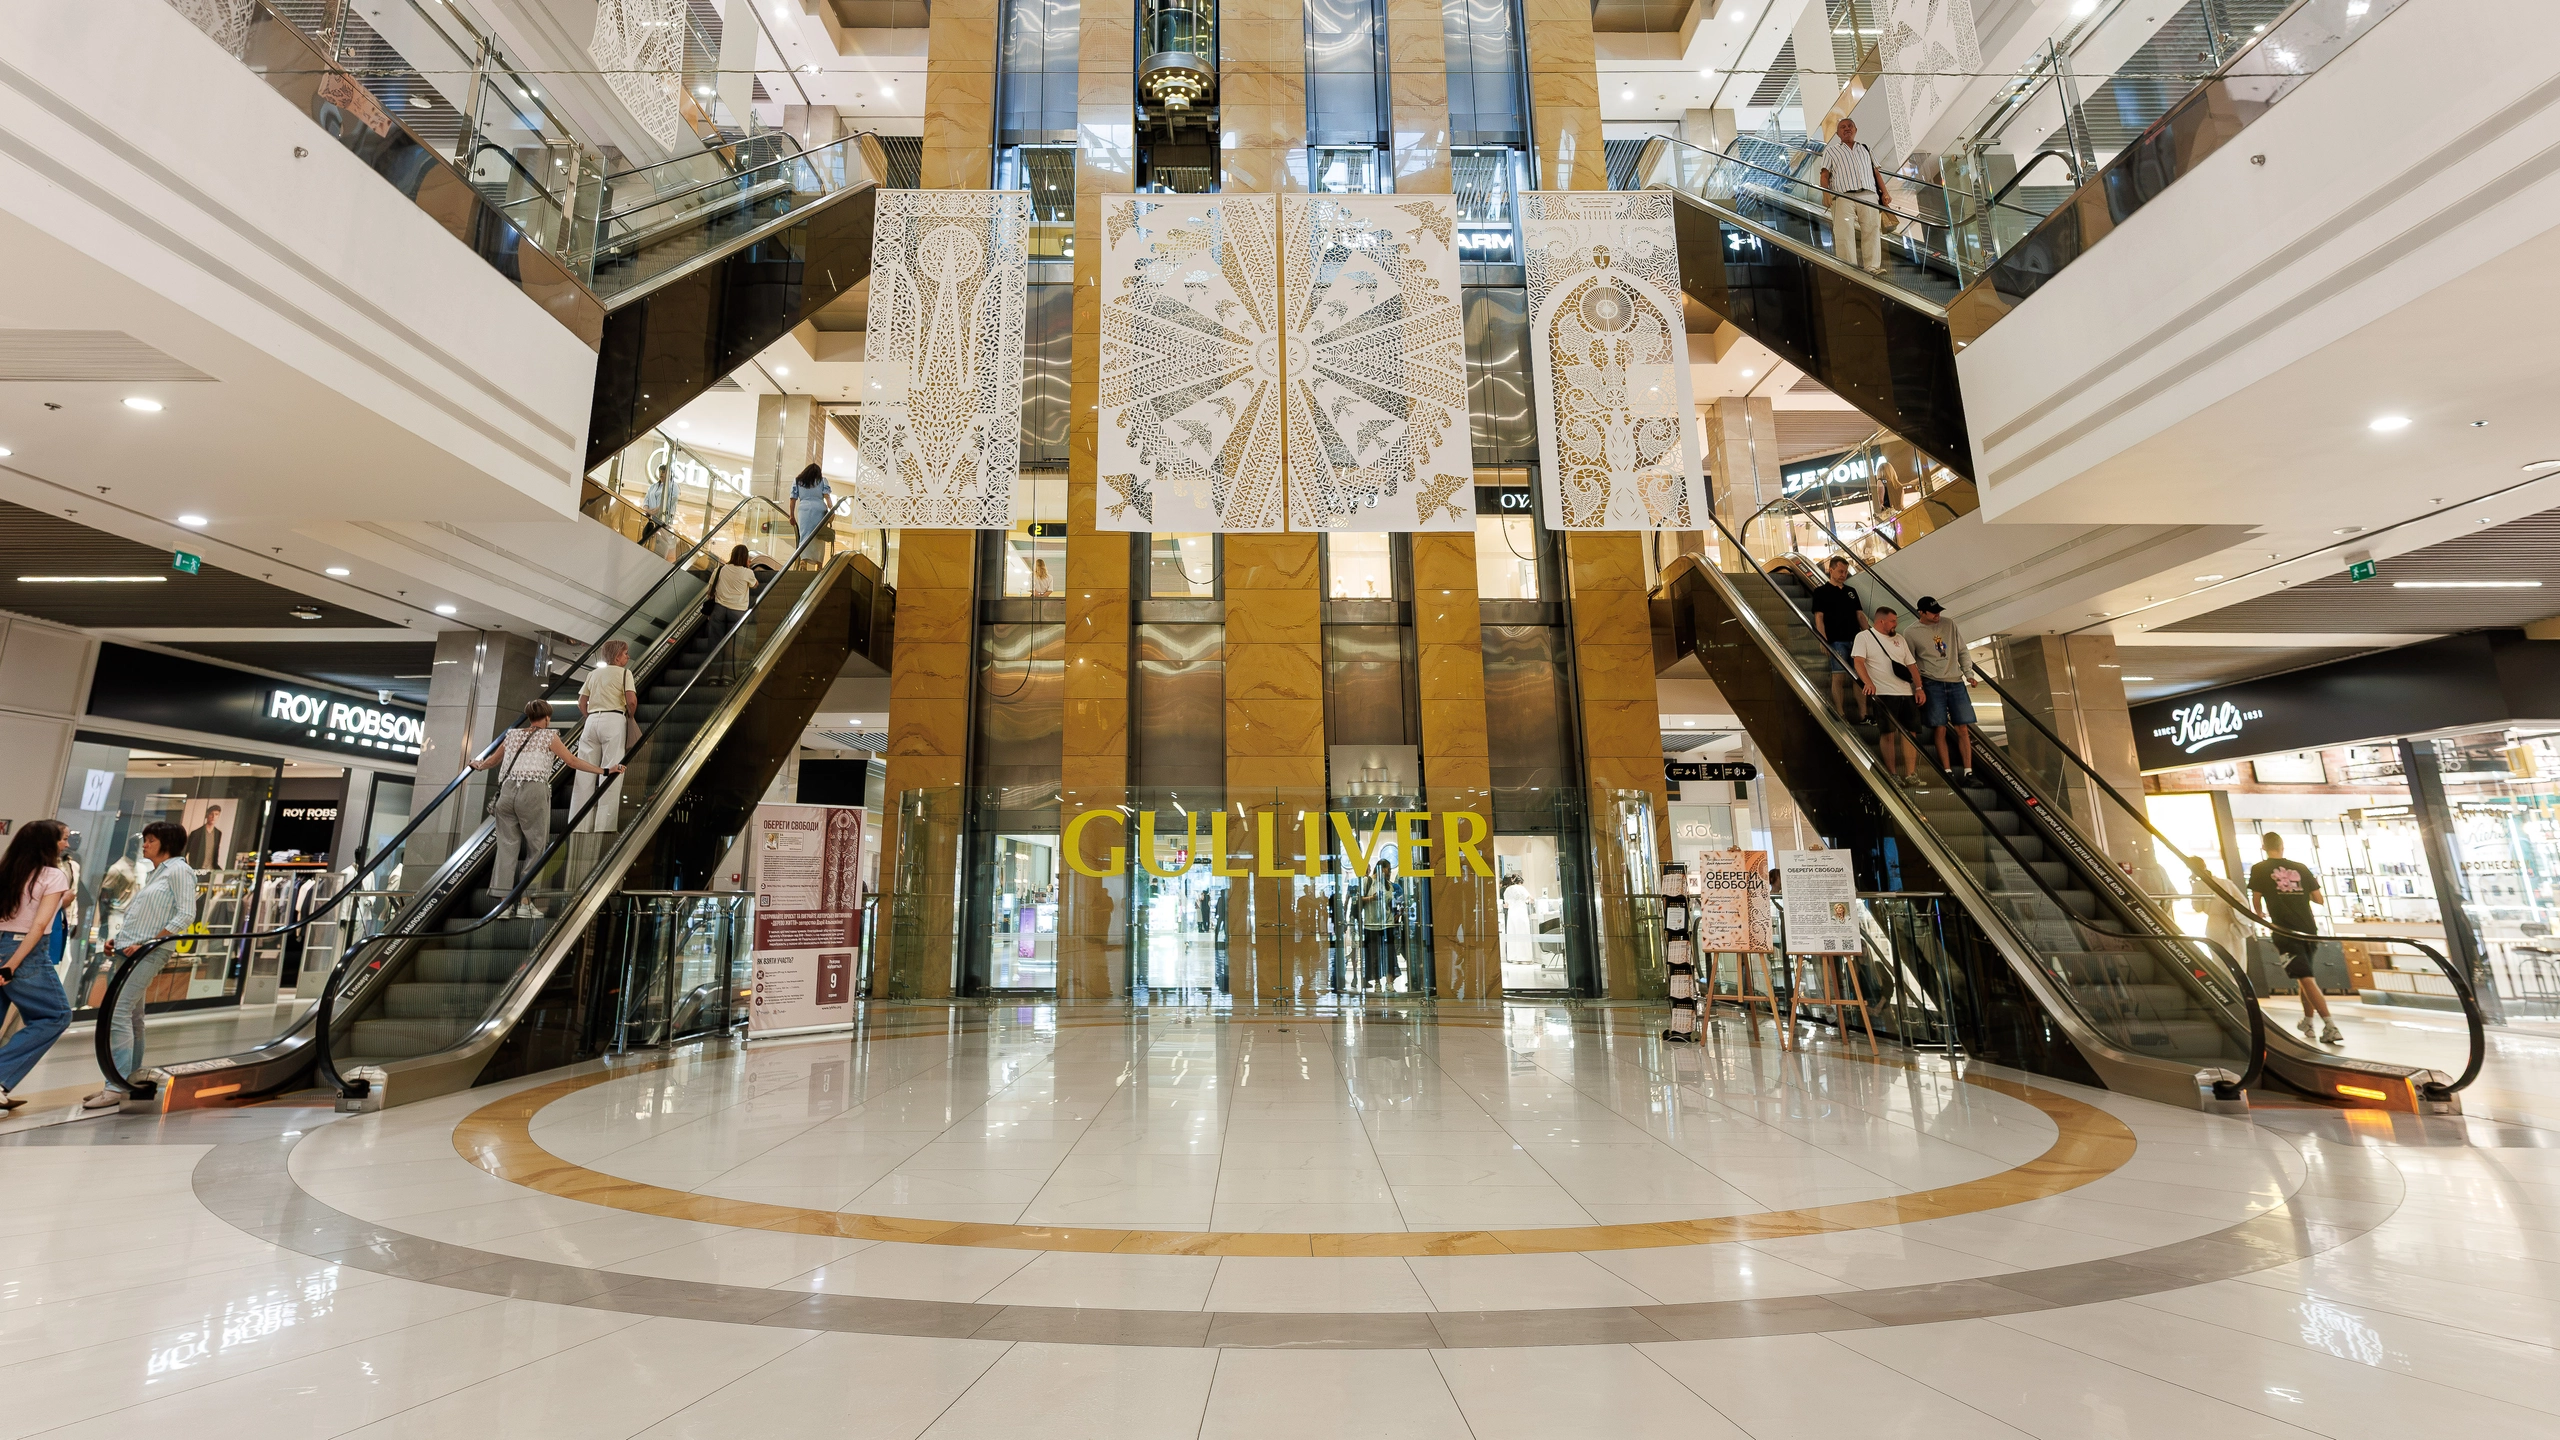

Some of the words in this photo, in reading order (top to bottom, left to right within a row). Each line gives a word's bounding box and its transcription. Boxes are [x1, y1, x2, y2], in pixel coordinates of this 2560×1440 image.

[1034, 525, 1042, 535] 2
[271, 689, 328, 725] ROY
[329, 702, 425, 744] ROBSON
[2171, 701, 2243, 747] Kiehl's
[282, 808, 306, 818] ROY
[763, 820, 790, 830] ОБЕРЕГИ
[791, 820, 819, 831] СВОБОДИ
[1062, 809, 1494, 878] GULLIVER
[1706, 871, 1758, 880] ОБЕРЕГИ
[1706, 880, 1764, 890] СВОБОДИ
[2110, 882, 2126, 897] БУЛО
[2134, 907, 2156, 928] КЛІНІКА
[830, 972, 837, 988] 9
